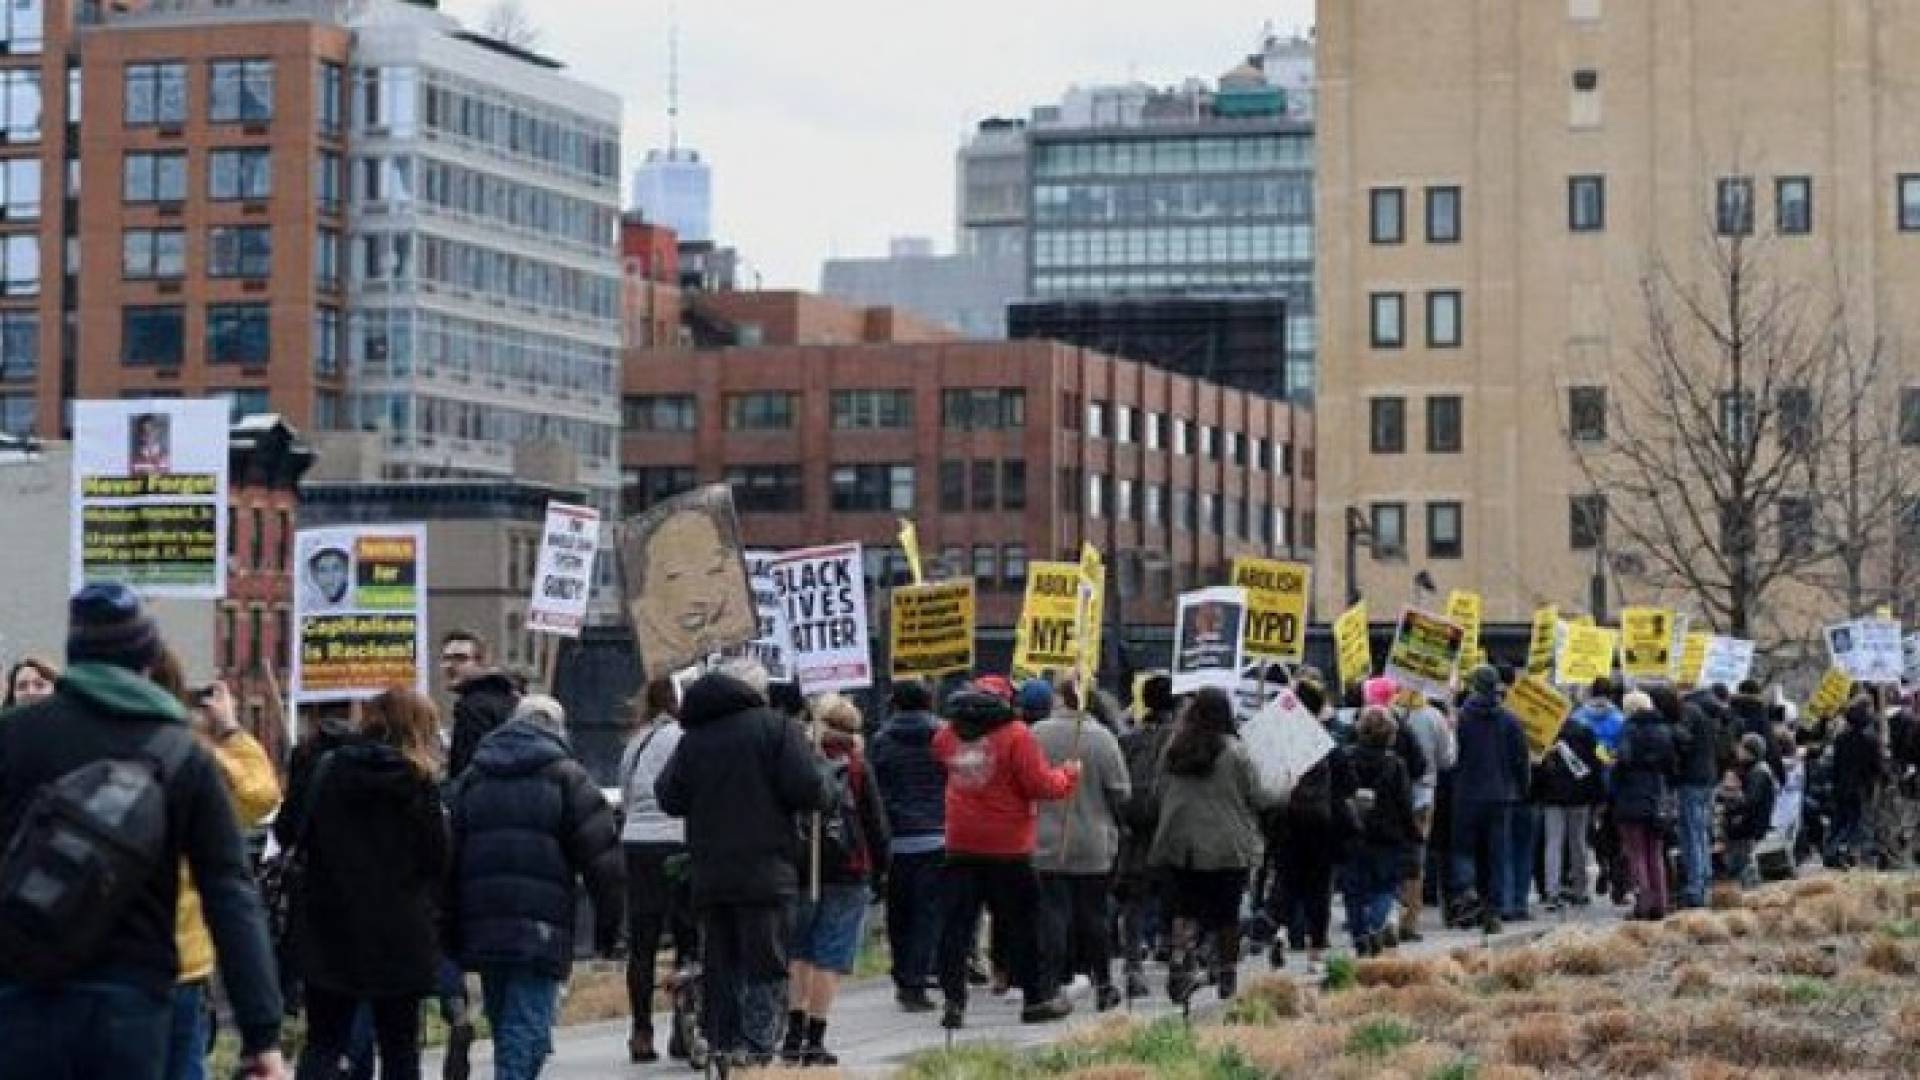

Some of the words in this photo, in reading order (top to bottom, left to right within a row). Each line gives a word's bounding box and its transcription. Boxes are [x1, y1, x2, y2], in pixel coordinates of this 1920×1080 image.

[1237, 565, 1304, 594] ABOLISH
[788, 588, 854, 621] IVES
[303, 617, 414, 637] Capitalism
[792, 617, 857, 653] ATTER
[328, 641, 414, 658] Racism!
